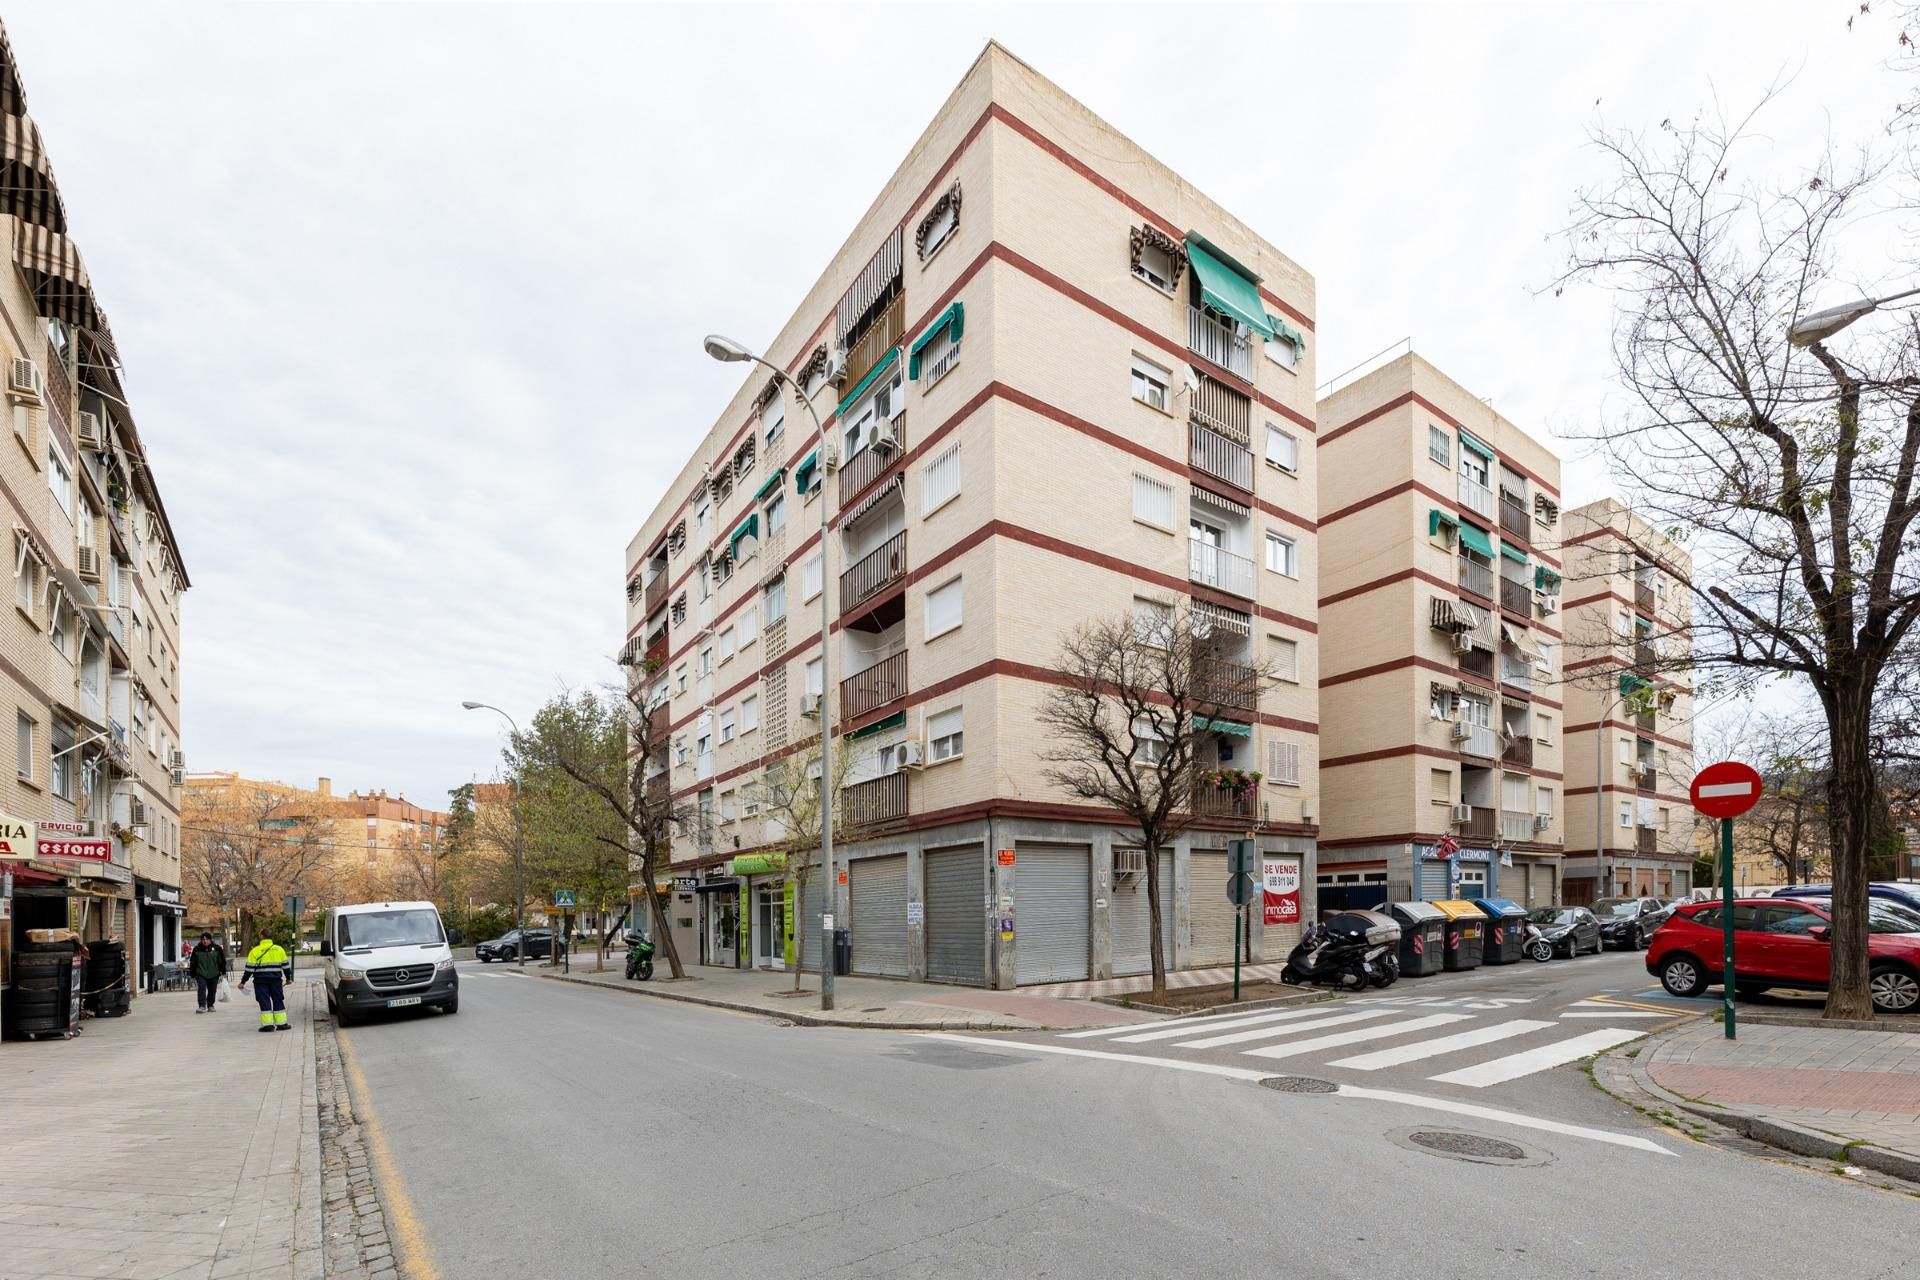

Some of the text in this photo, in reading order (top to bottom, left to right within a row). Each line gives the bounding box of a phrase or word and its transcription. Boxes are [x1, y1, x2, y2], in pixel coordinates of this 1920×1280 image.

[0, 824, 26, 838] IA
[38, 822, 83, 831] ERVICIO
[1460, 850, 1490, 860] CLERMONT
[1264, 864, 1297, 874] SE VENDE
[1265, 904, 1296, 914] inmocasa
